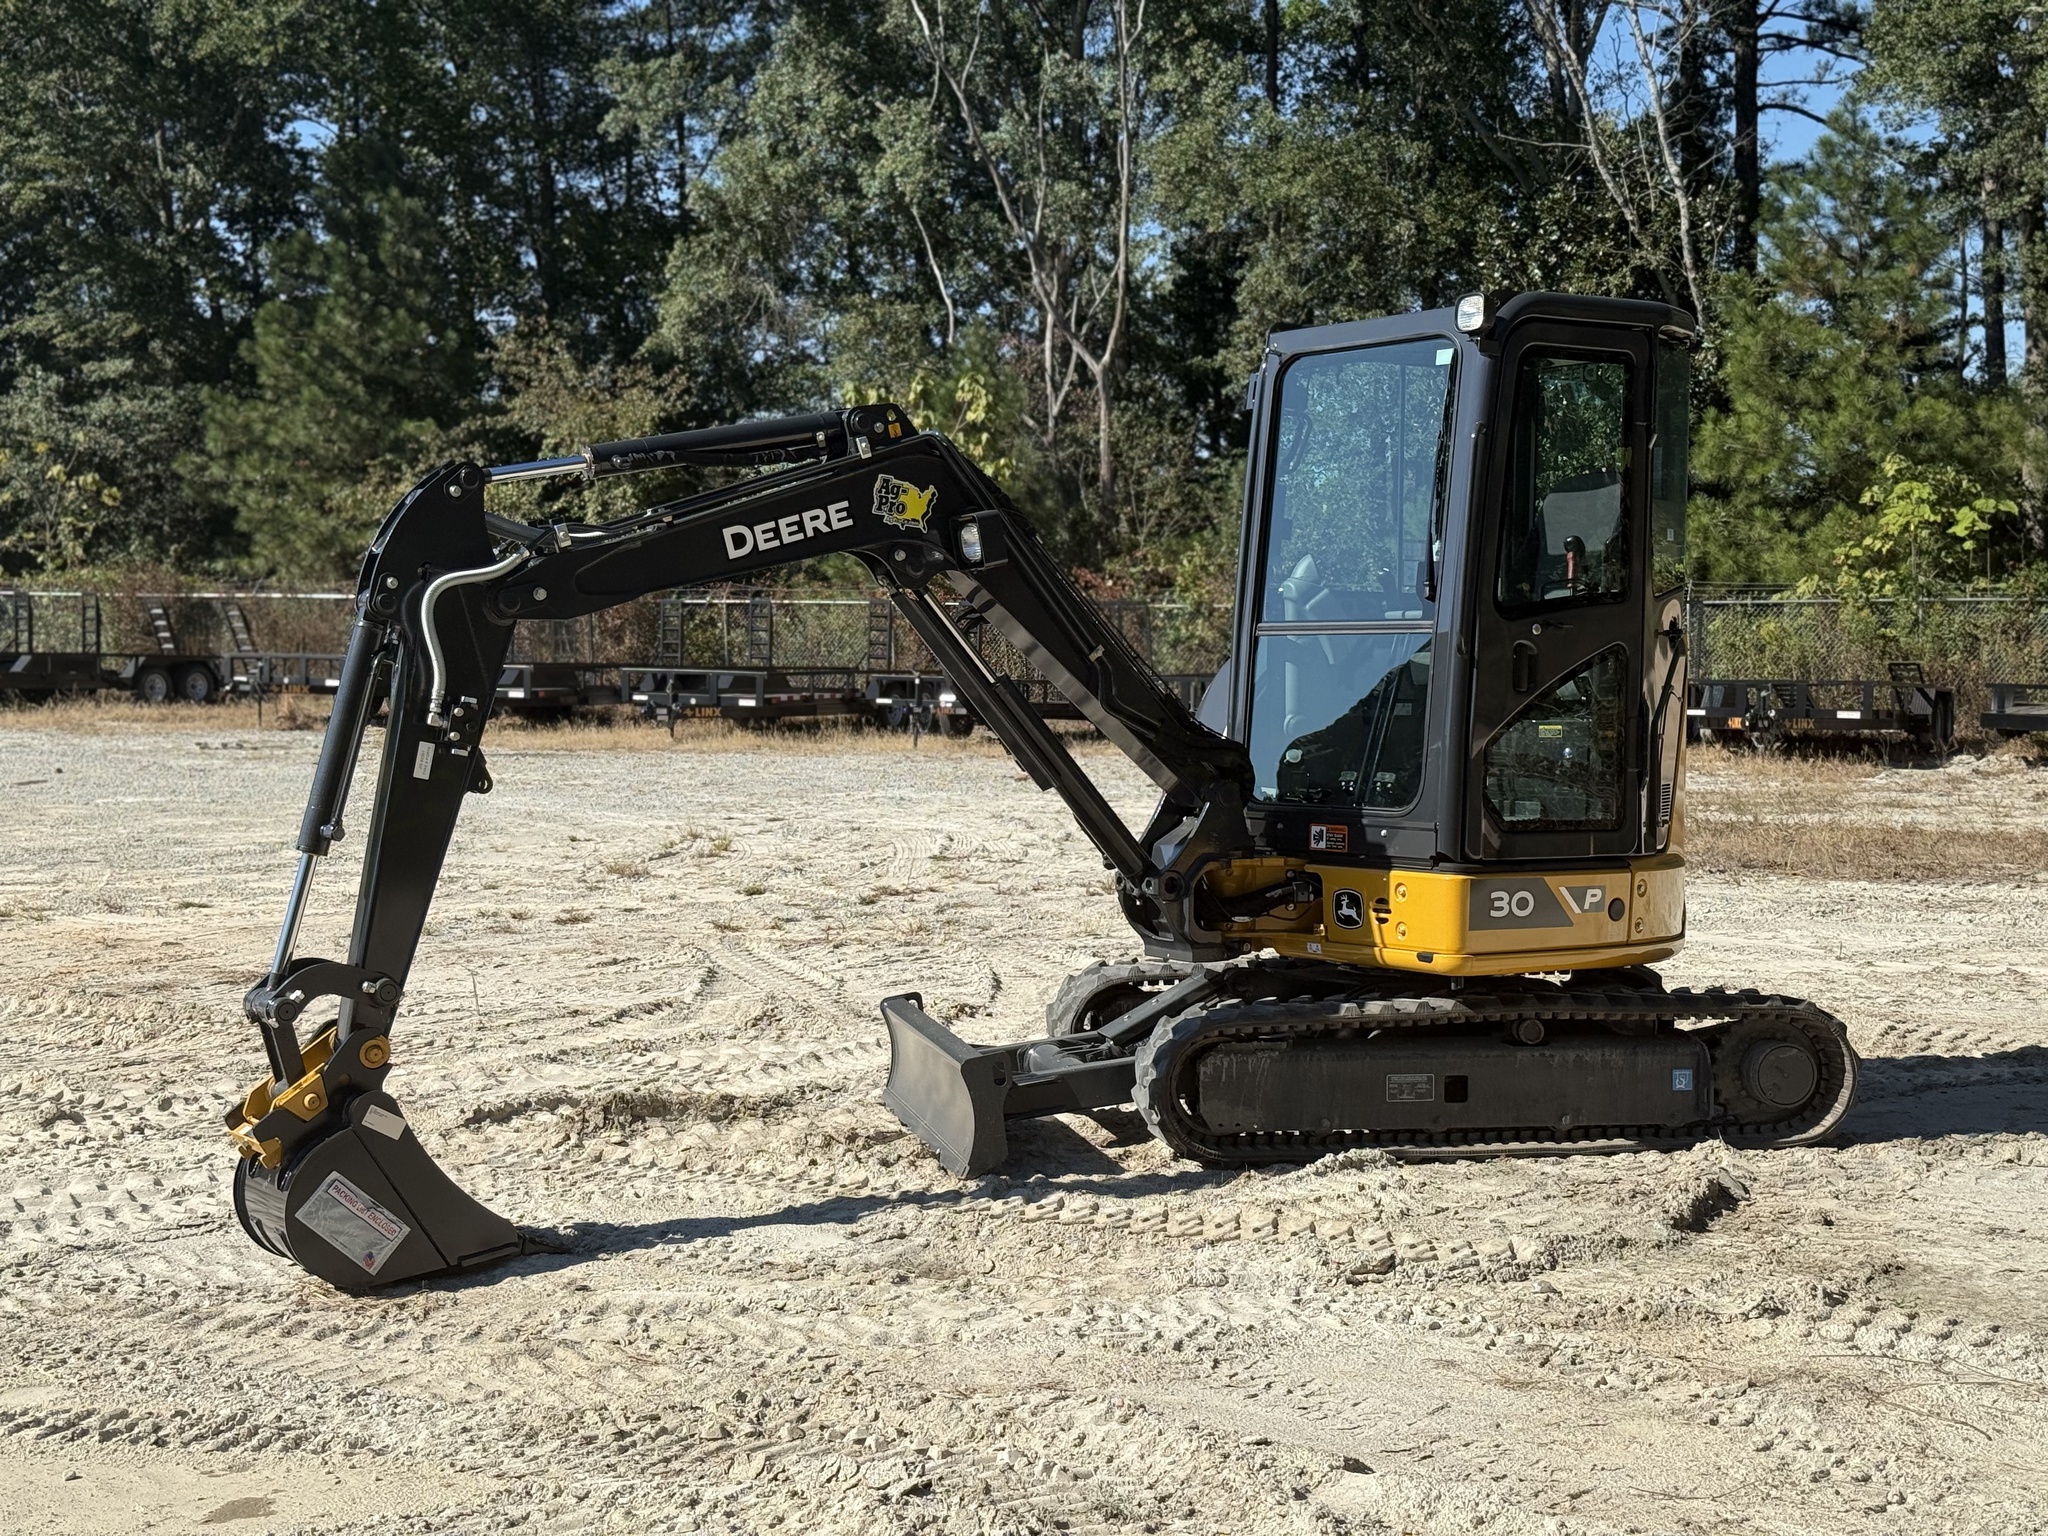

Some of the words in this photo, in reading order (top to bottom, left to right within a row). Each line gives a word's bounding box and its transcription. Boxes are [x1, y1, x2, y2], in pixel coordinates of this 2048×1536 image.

[877, 477, 908, 500] Ag-
[876, 495, 907, 514] Pro
[722, 500, 854, 560] DEERE
[281, 685, 310, 694] LINX
[695, 707, 722, 717] LINX
[1792, 718, 1815, 729] LINX
[1489, 890, 1535, 918] 30
[1583, 888, 1603, 910] P
[332, 1184, 358, 1208] PACKING
[367, 1211, 397, 1236] ENCLOSED
